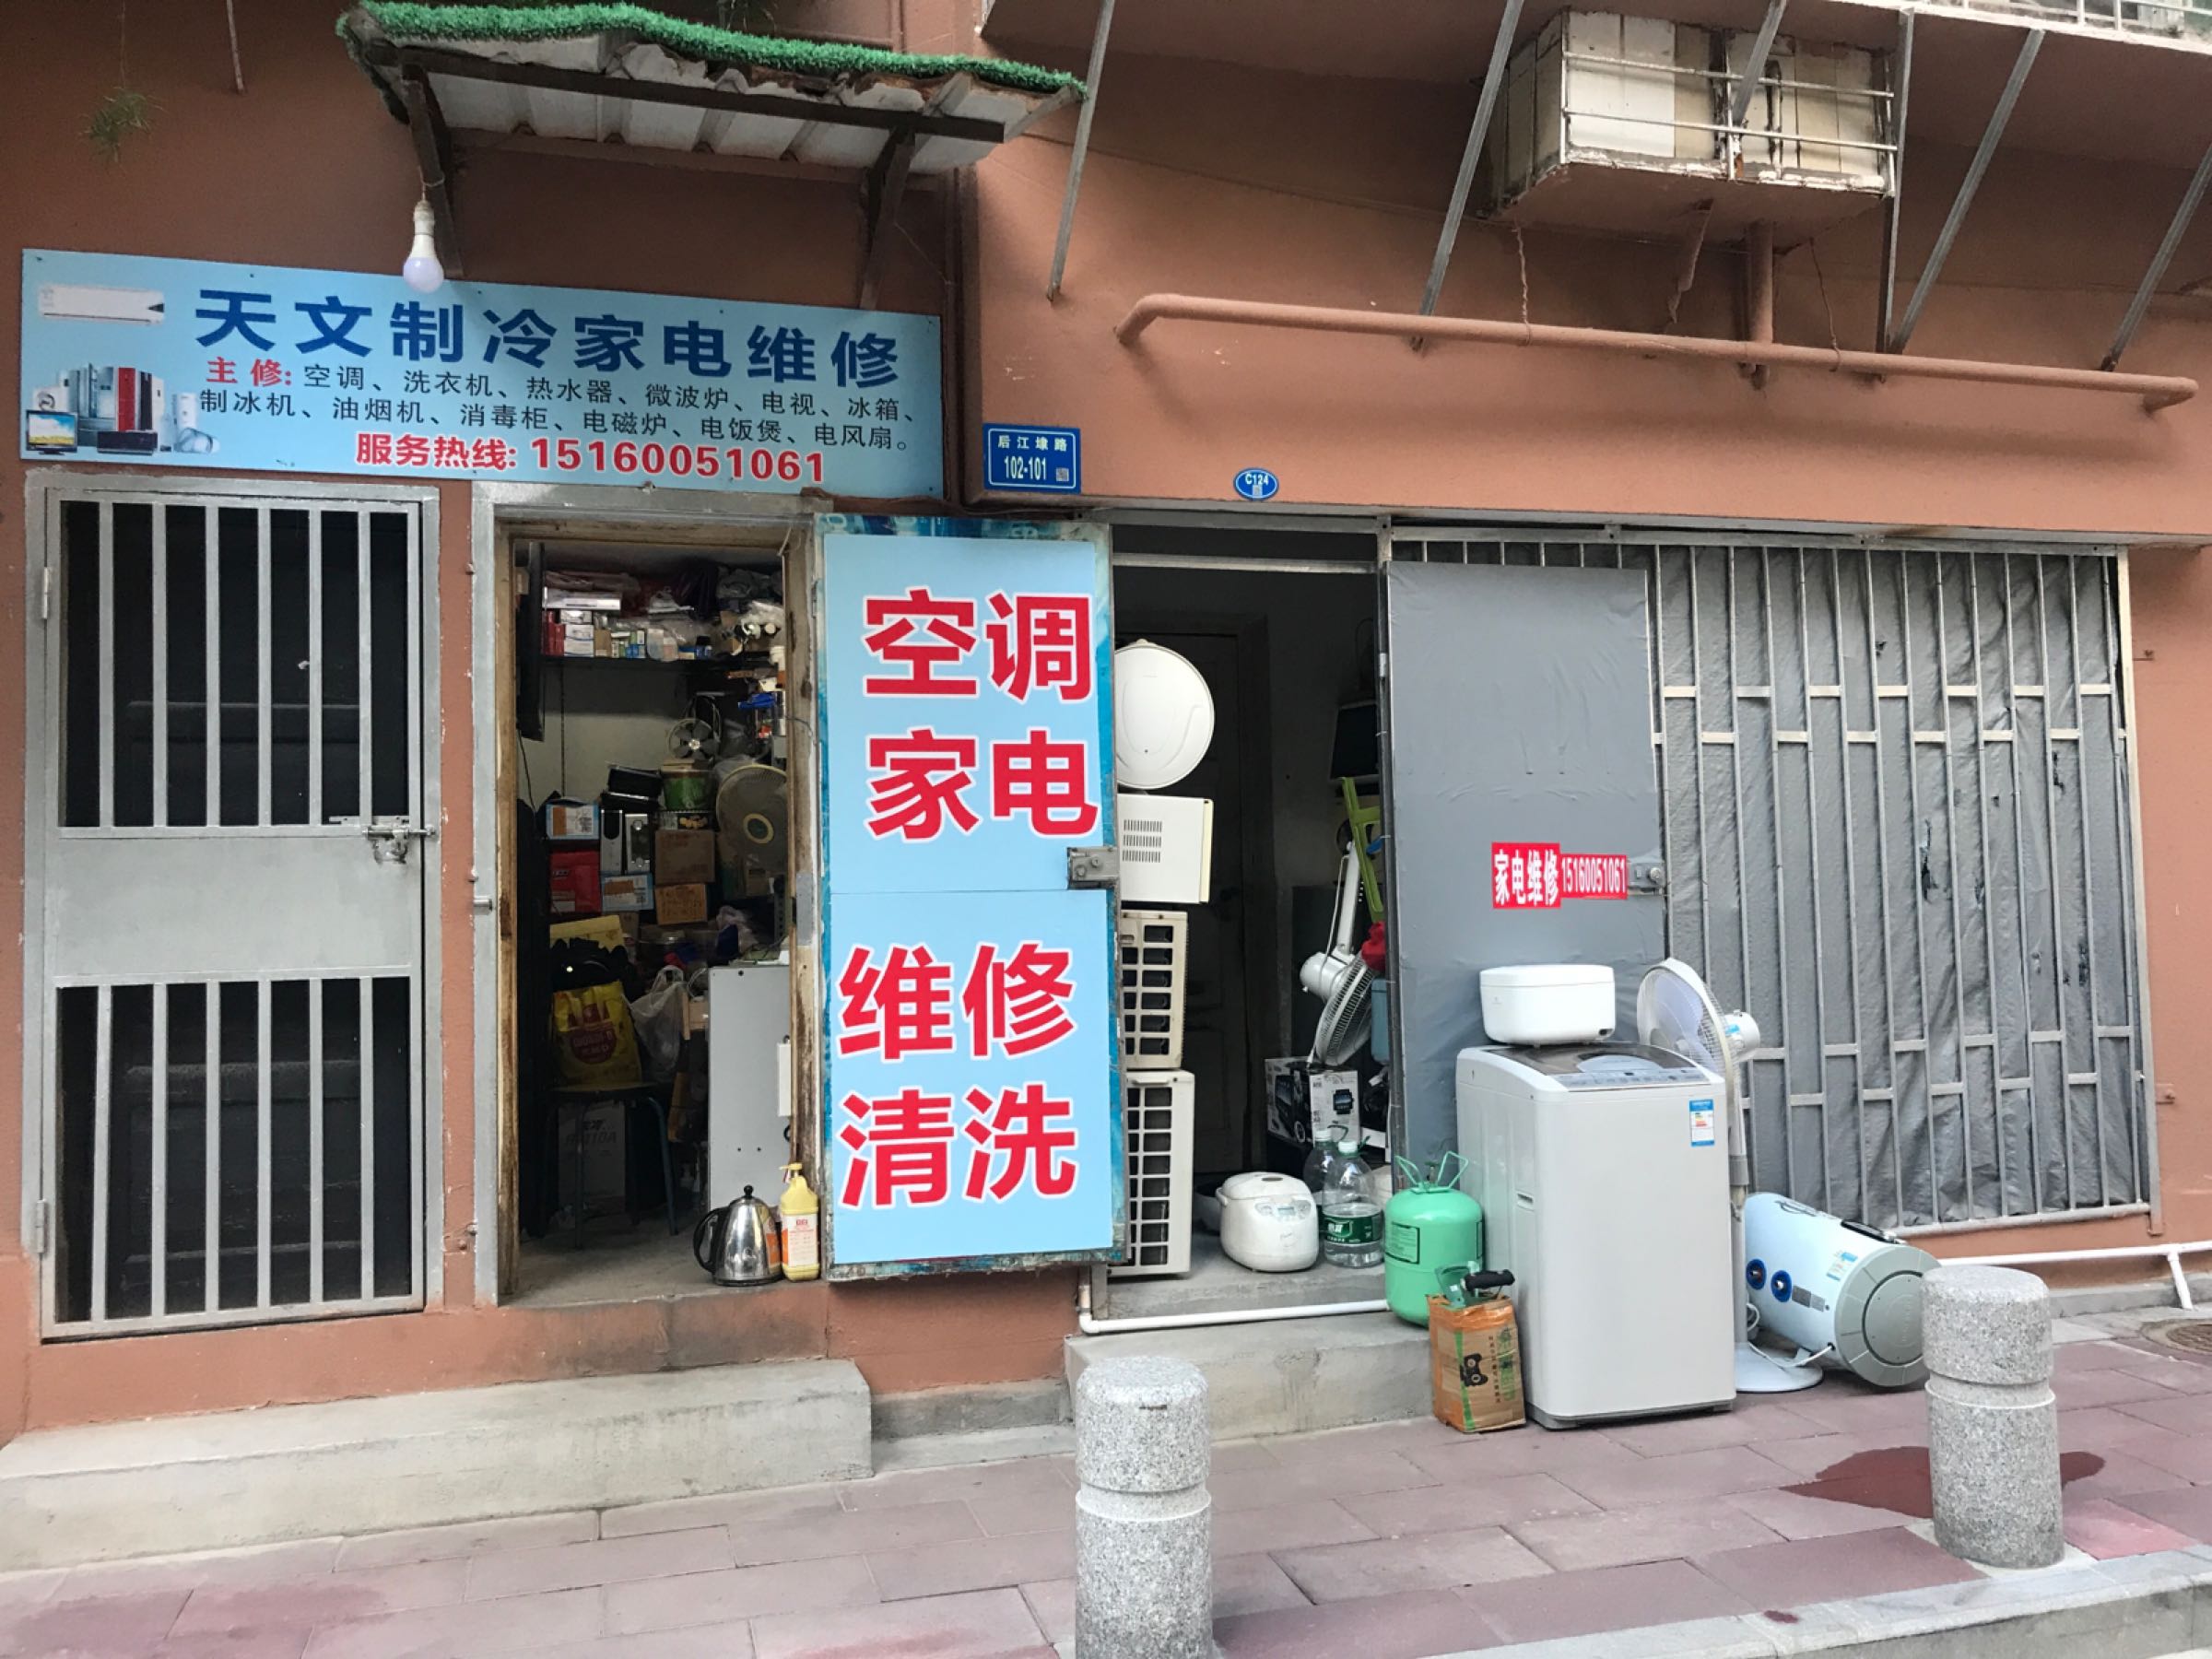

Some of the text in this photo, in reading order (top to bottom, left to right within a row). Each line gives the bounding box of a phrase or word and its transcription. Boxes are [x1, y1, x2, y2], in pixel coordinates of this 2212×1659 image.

[194, 288, 900, 390] 天文制冷家电维修
[199, 388, 908, 452] 制冰机、油烟机、消毒柜、电磁炉、电饭煲、电风扇。
[1004, 455, 1047, 480] 102-101
[1245, 472, 1269, 486] C124
[863, 586, 1091, 702] 空调
[866, 727, 1100, 841] 家电
[1494, 848, 1627, 907] 家电维修 15160051061
[838, 942, 1076, 1061] 维修
[839, 1083, 1077, 1208] 清洗
